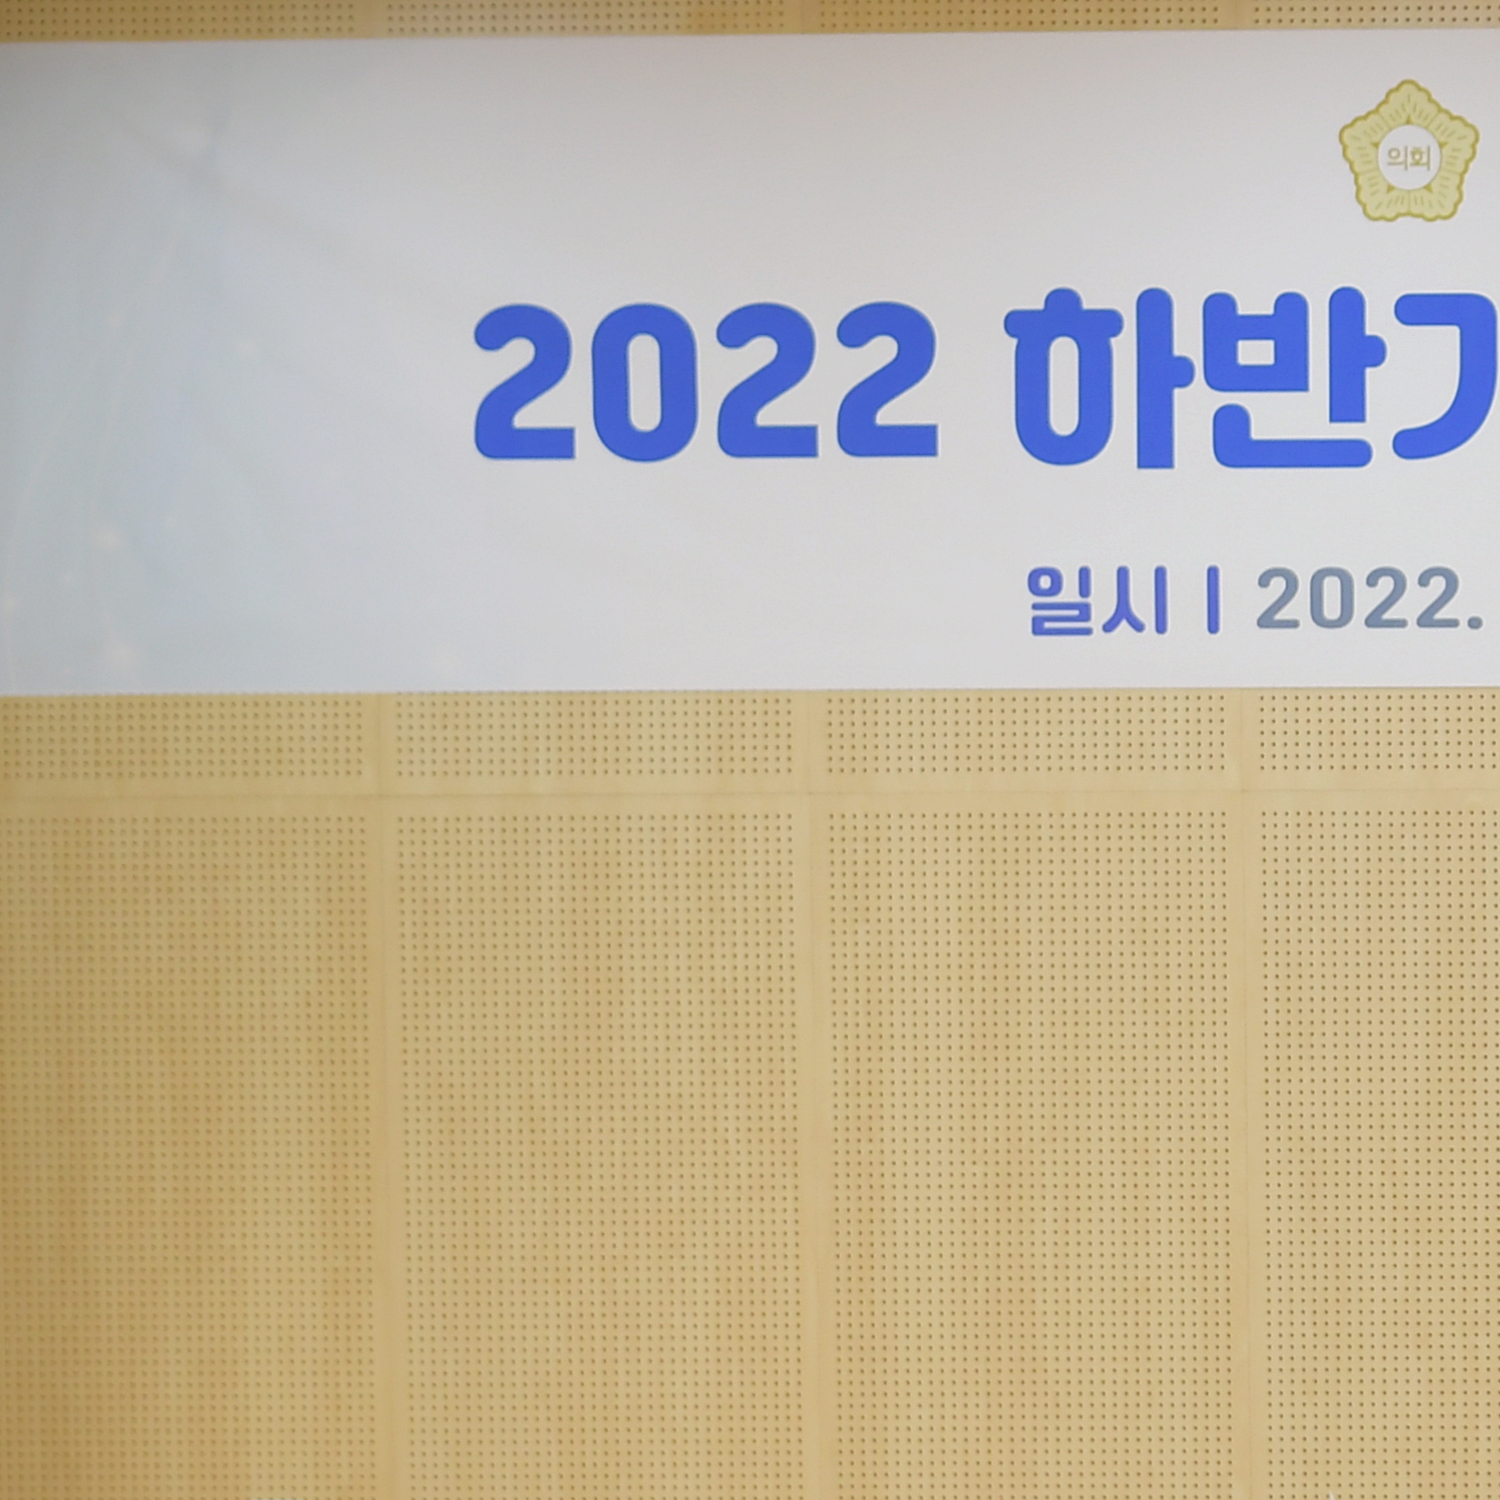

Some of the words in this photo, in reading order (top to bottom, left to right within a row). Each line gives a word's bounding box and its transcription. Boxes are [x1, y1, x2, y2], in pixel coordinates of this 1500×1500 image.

[1387, 145, 1431, 172] 의회
[472, 300, 940, 465] 2022
[1026, 564, 1169, 637] 일시
[1256, 566, 1484, 630] 2022.
